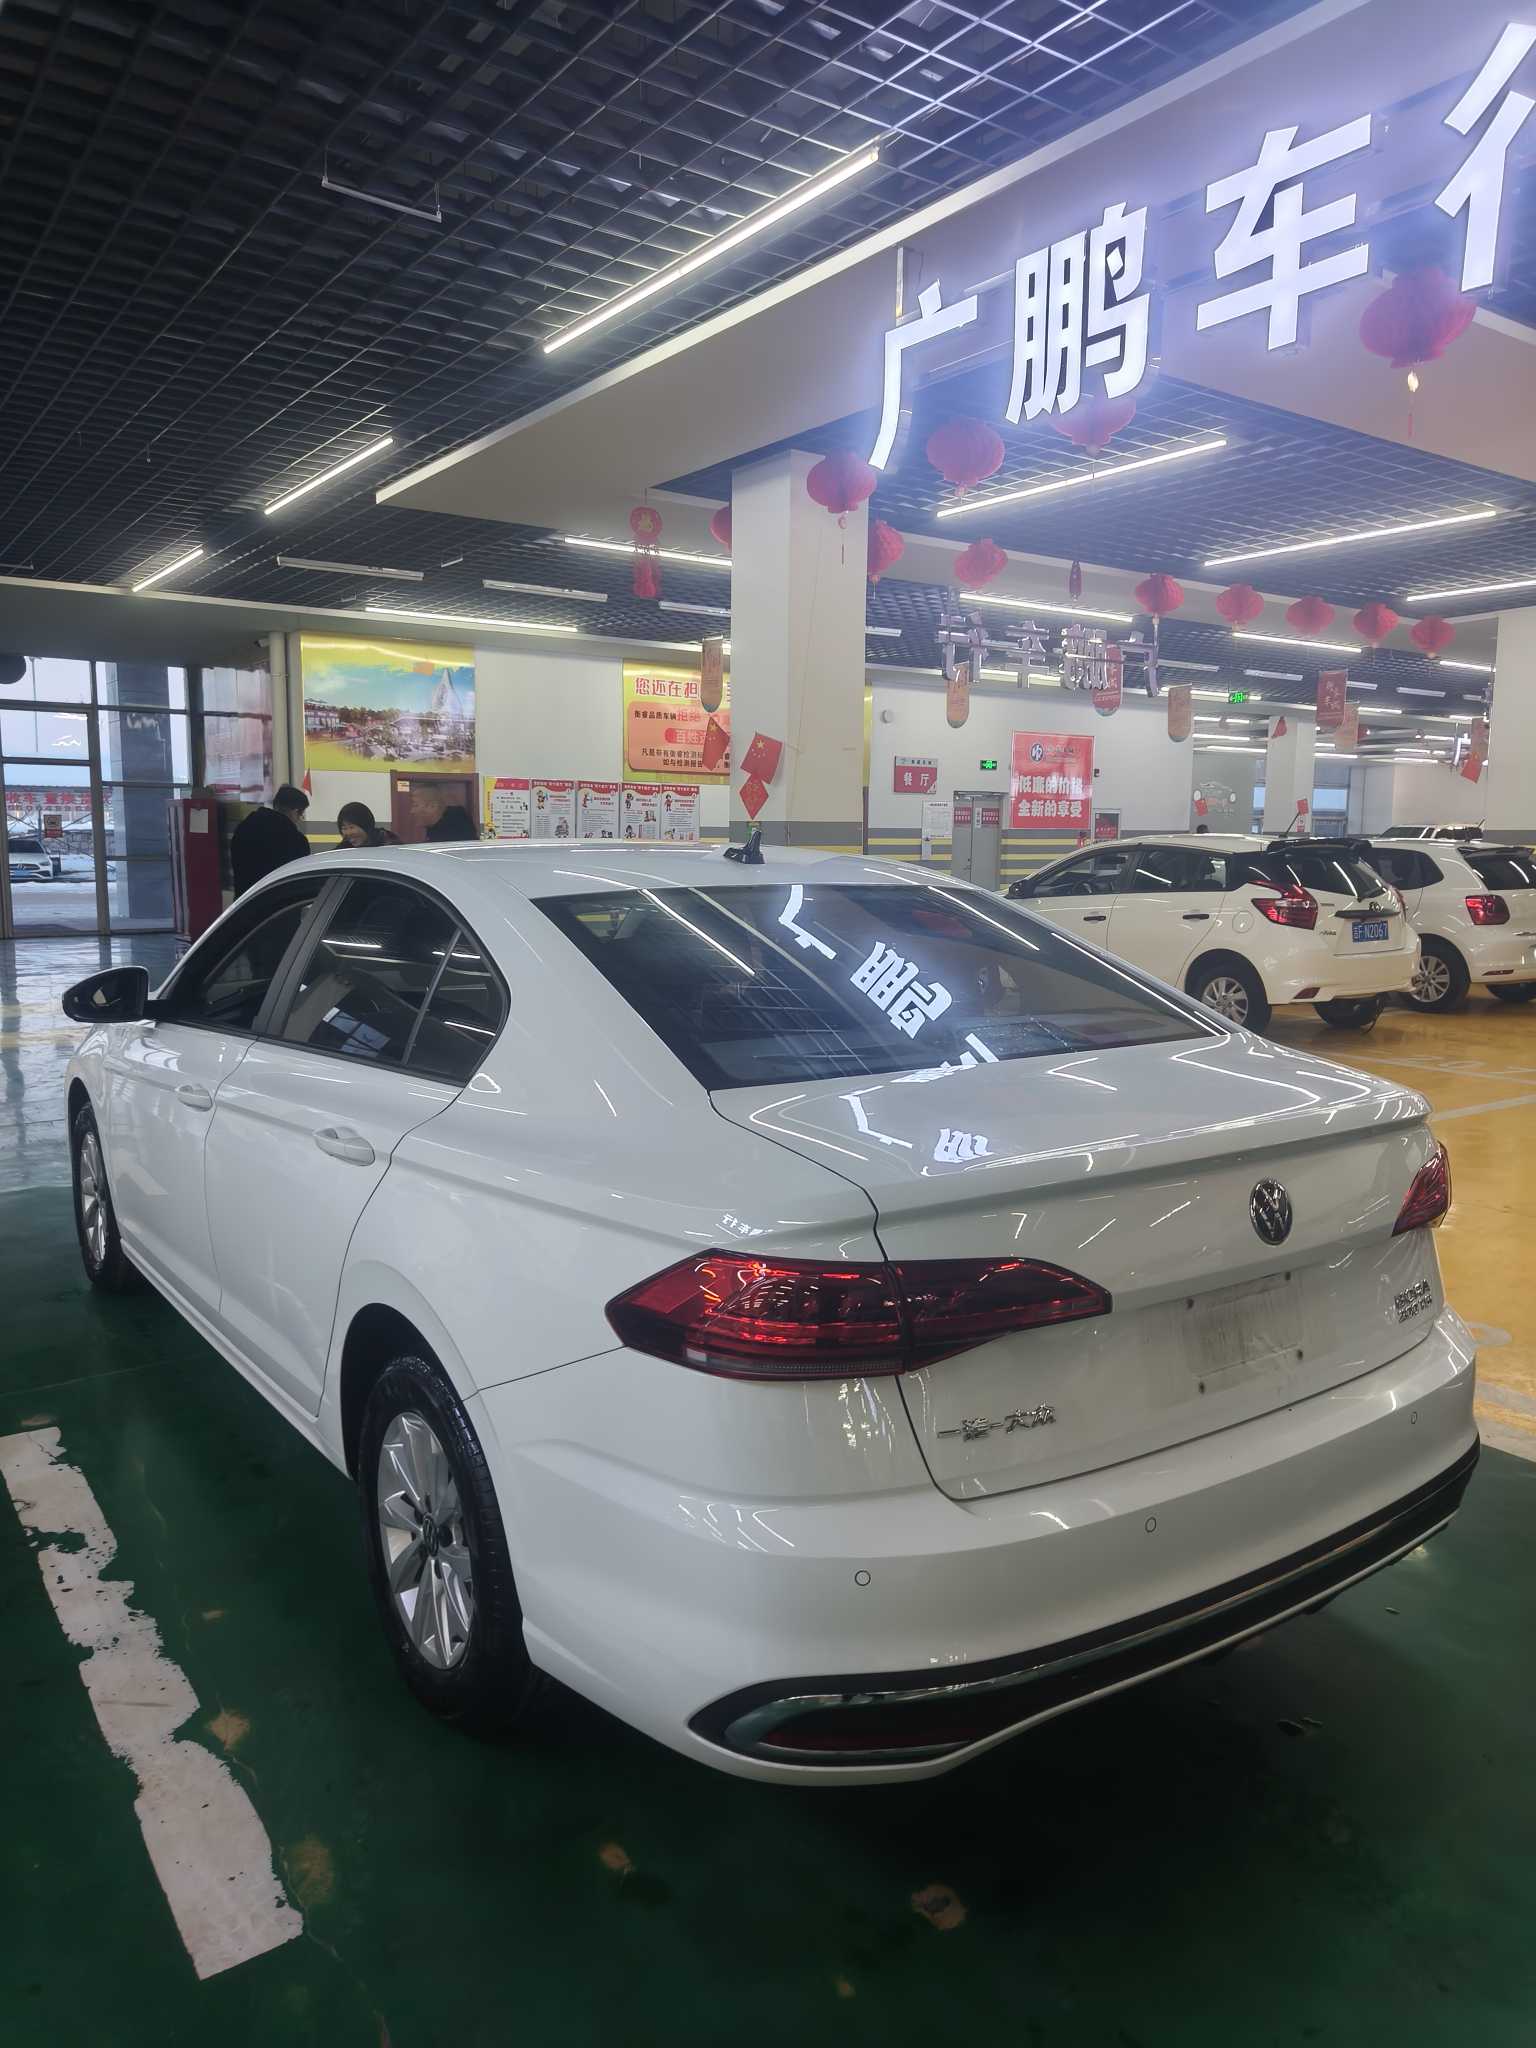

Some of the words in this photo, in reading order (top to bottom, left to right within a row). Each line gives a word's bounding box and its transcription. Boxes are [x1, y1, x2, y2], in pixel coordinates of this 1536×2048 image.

[904, 772, 929, 786] 餐厅
[1018, 799, 1083, 818] 全新的享受
